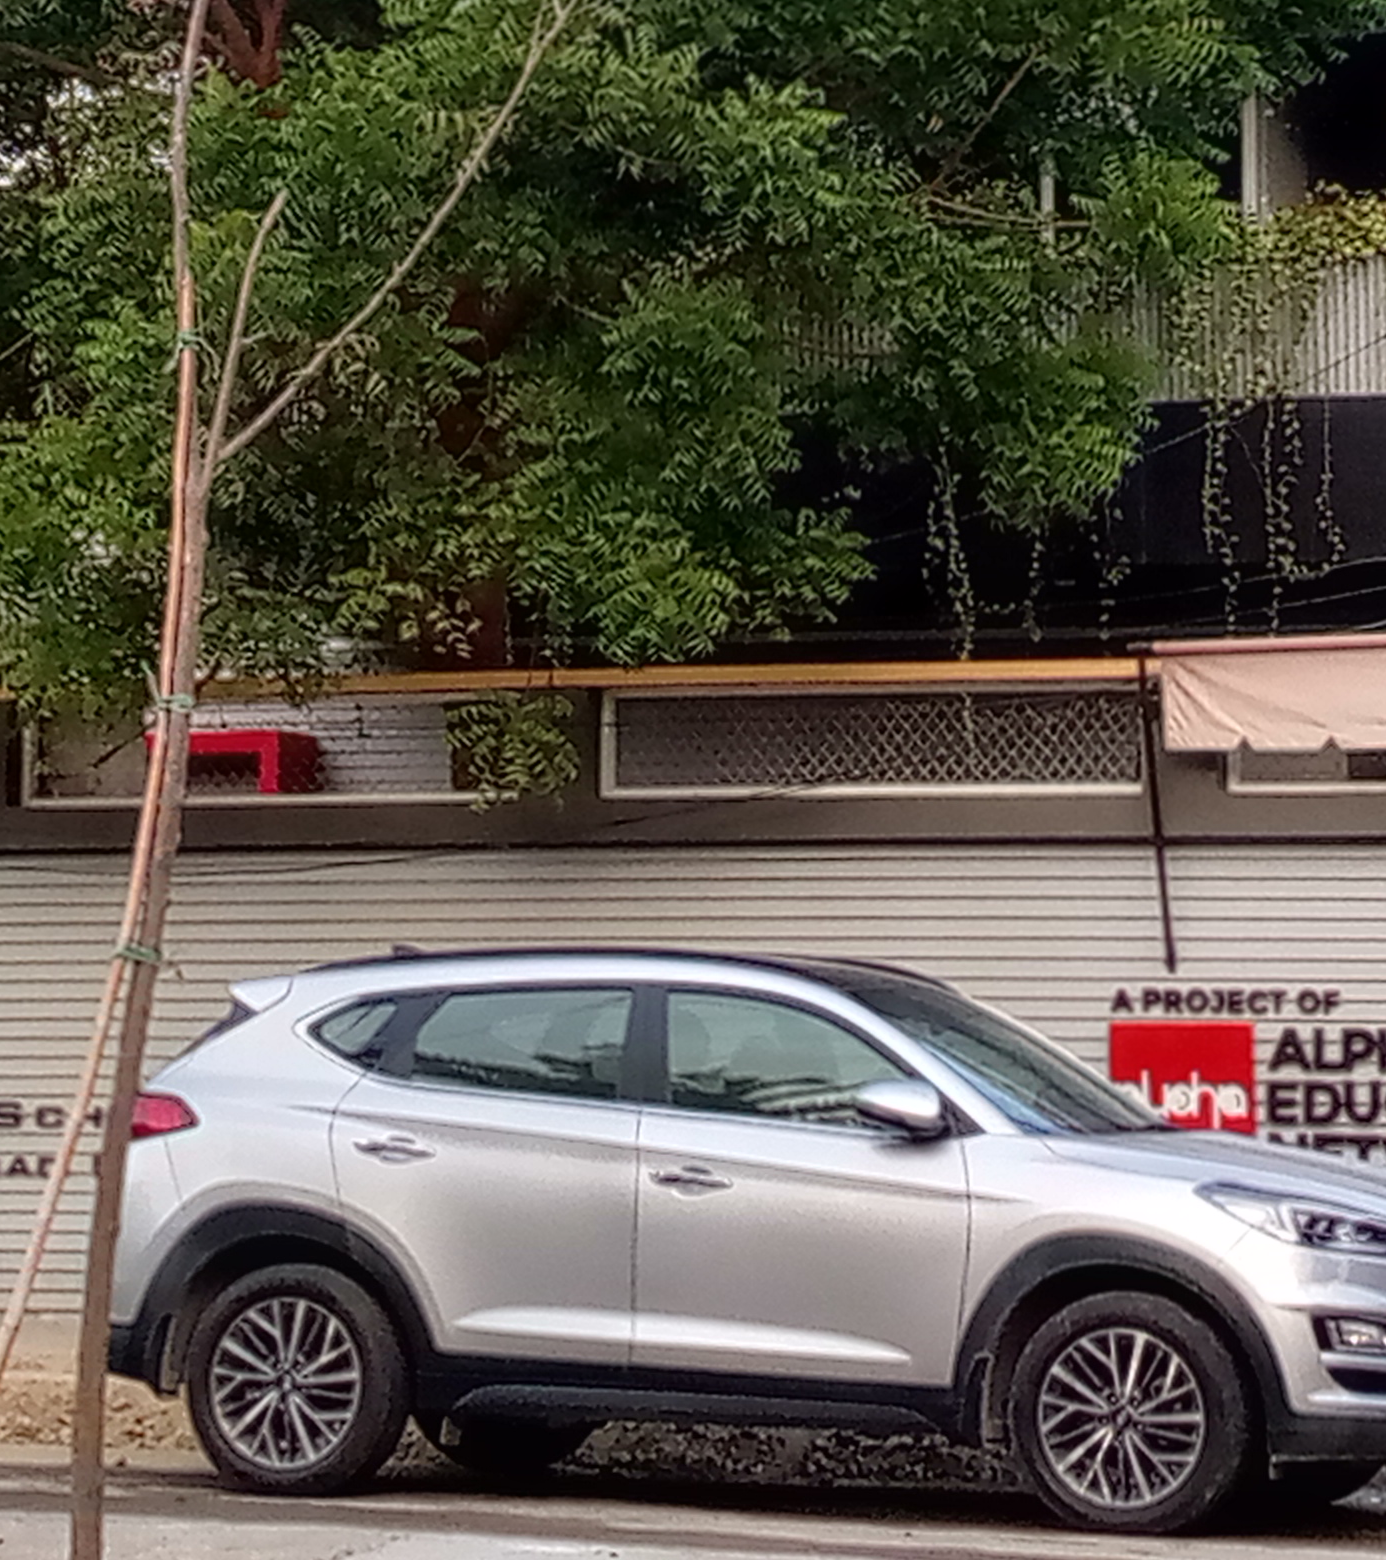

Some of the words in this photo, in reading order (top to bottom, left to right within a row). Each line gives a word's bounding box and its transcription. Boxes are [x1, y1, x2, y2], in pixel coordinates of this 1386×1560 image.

[1112, 989, 1134, 1014] A
[1143, 989, 1286, 1015] PROJECT
[1296, 989, 1340, 1015] OF
